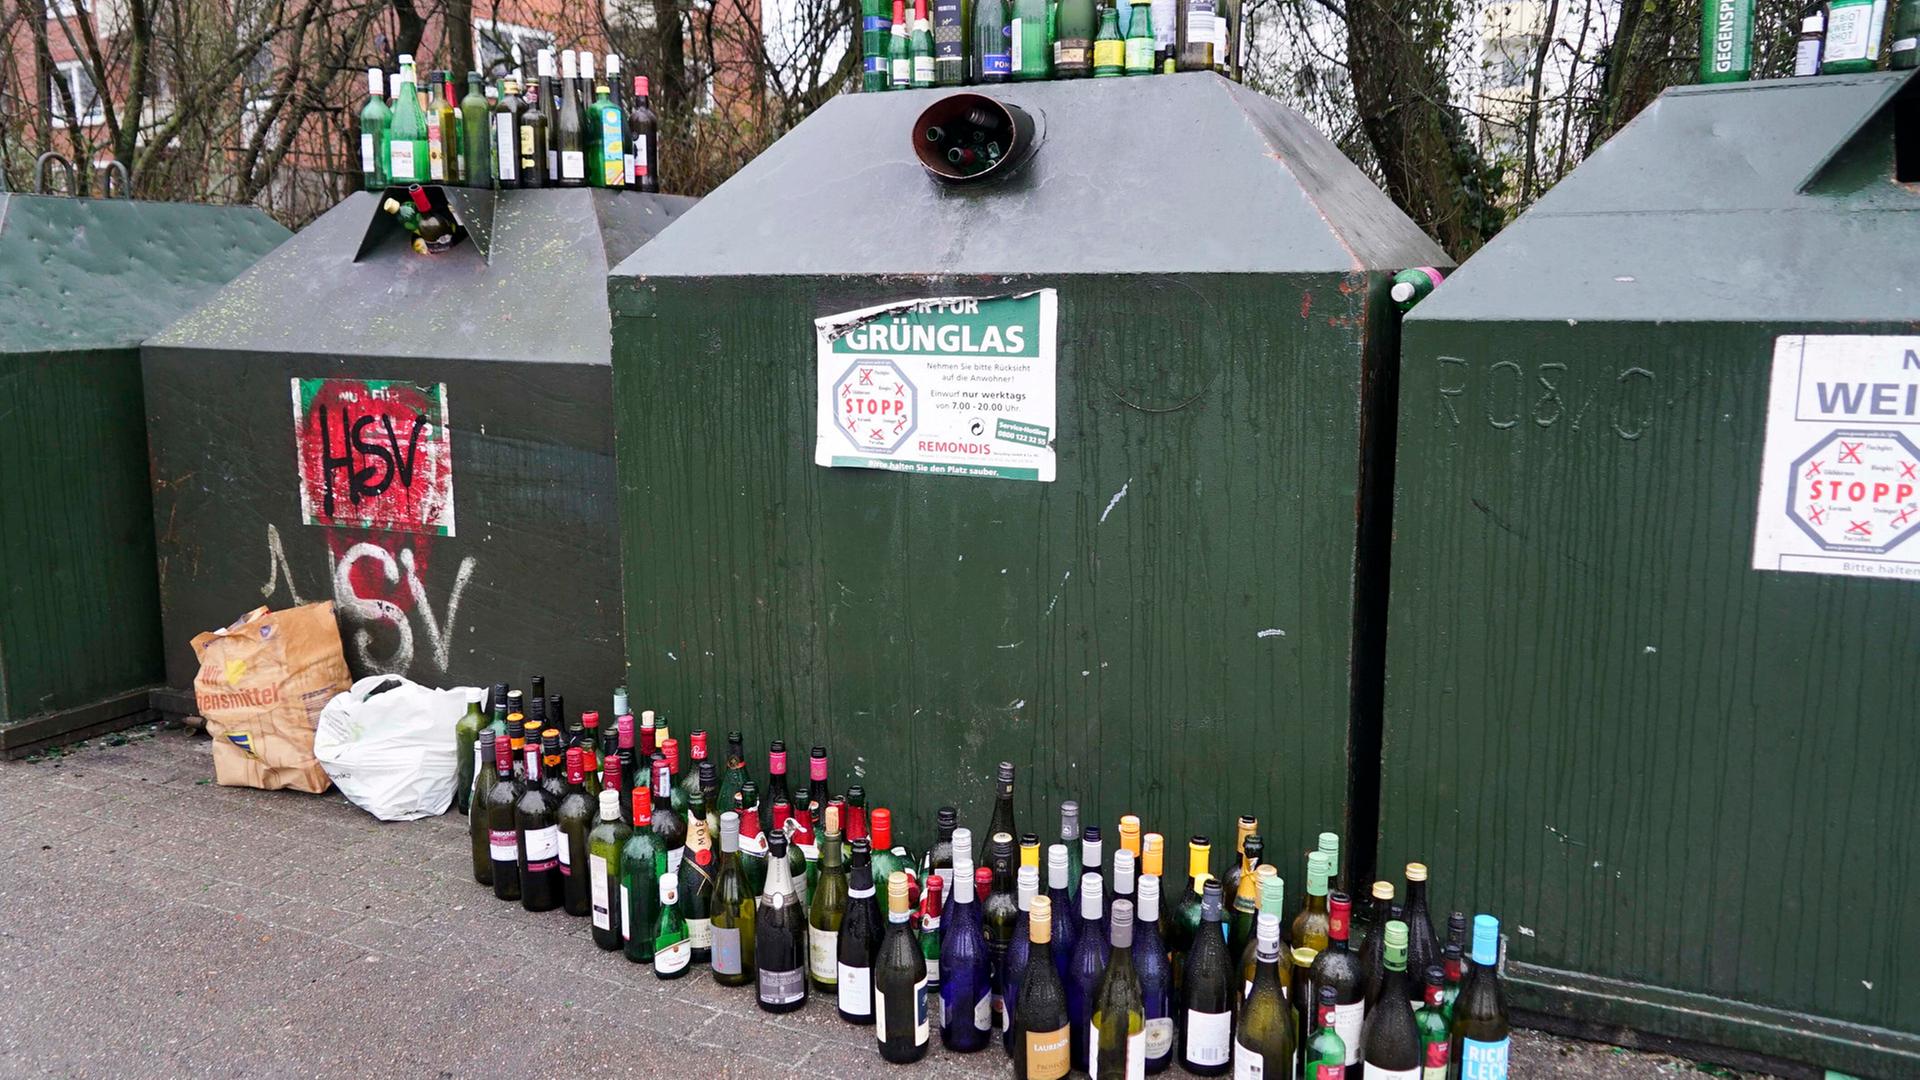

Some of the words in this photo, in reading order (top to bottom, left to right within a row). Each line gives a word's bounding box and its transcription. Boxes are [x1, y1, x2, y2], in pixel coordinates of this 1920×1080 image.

[845, 317, 1025, 354] GRÜNGLAS
[926, 362, 959, 371] Nehmen
[960, 362, 972, 371] Sie
[974, 363, 993, 371] bitte
[942, 373, 955, 382] auf
[956, 373, 969, 382] die
[930, 389, 961, 398] Einwurf
[962, 391, 979, 399] nur
[981, 391, 1027, 403] werktags
[846, 397, 905, 416] STOPP
[935, 402, 950, 410] von
[952, 401, 971, 411] 7.00
[977, 402, 1003, 412] 20.00
[918, 440, 991, 456] REMONDIS
[319, 404, 428, 518] HSV
[889, 461, 915, 472] halten
[915, 463, 929, 472] Sie
[929, 464, 946, 473] den
[947, 465, 968, 475] Platz
[968, 466, 1000, 477] sauber.
[1809, 480, 1914, 504] STOPP
[1843, 562, 1874, 573] Bitte
